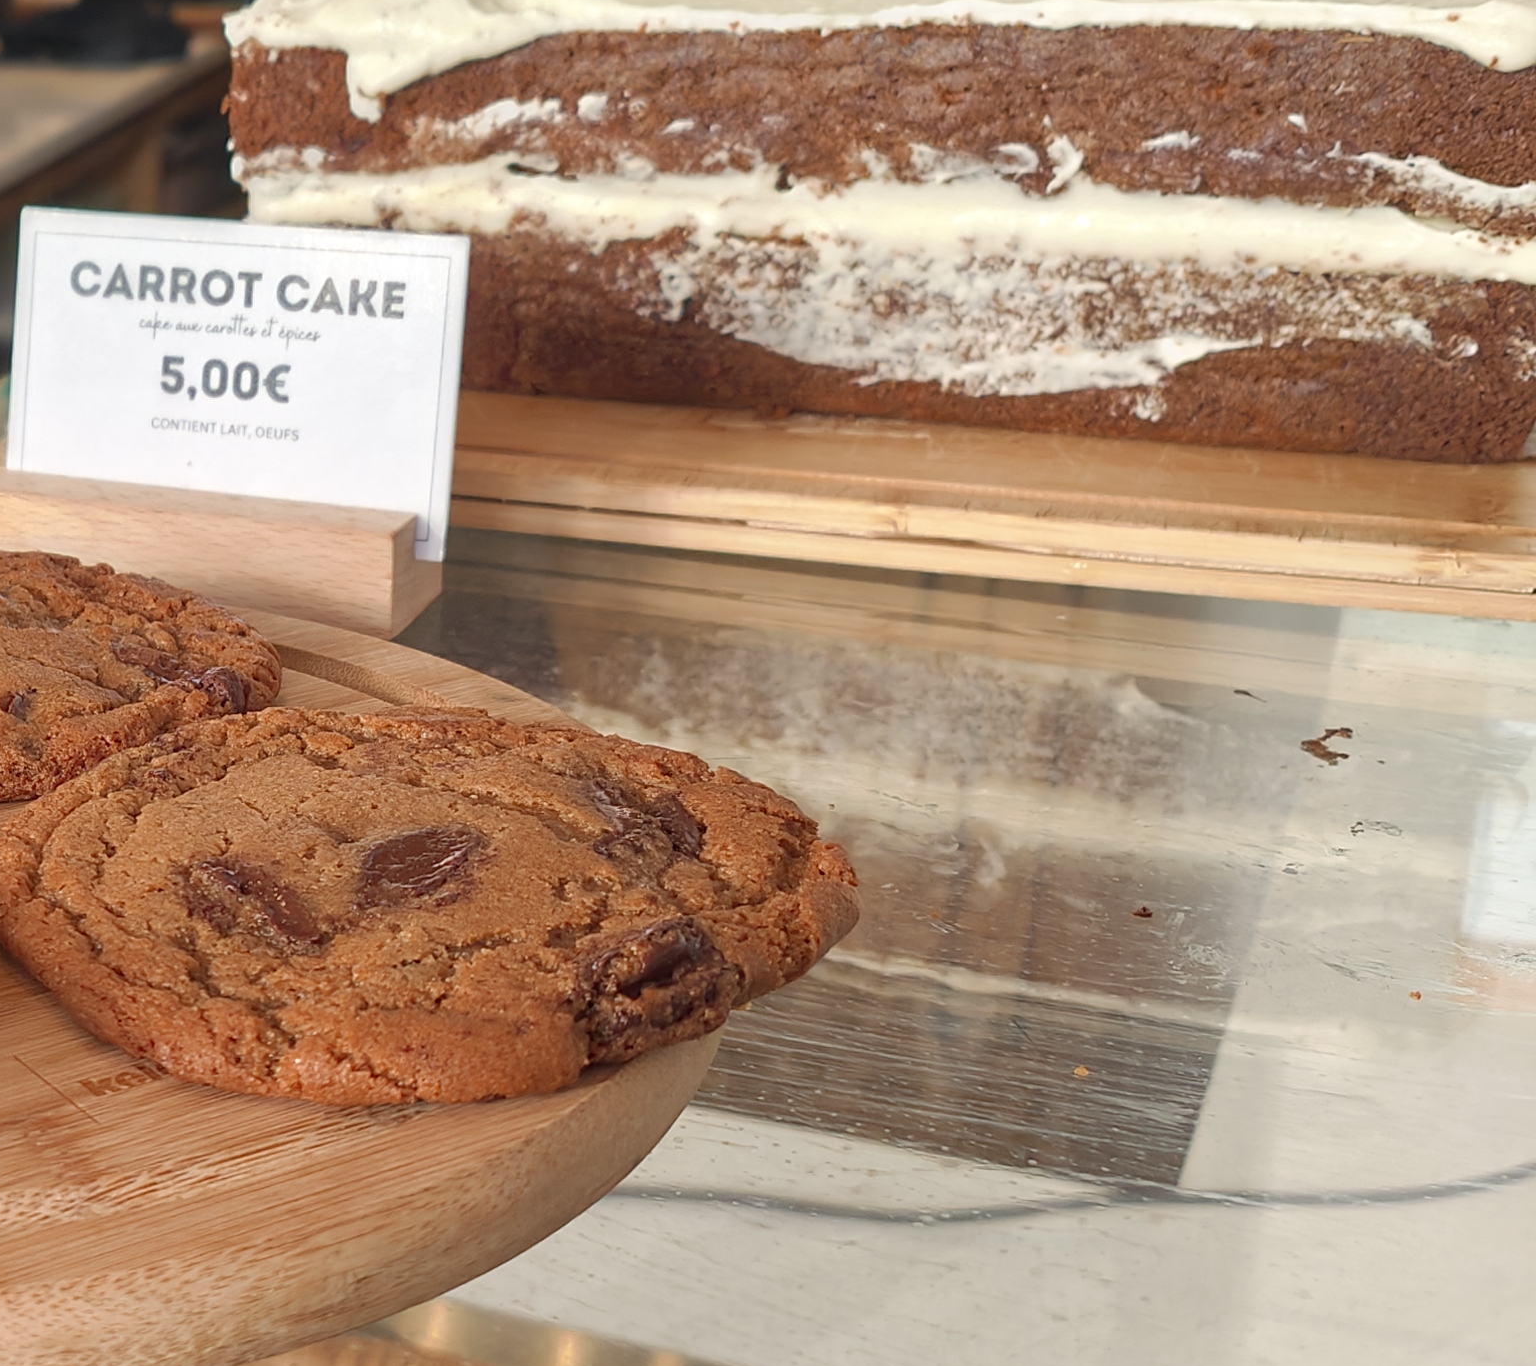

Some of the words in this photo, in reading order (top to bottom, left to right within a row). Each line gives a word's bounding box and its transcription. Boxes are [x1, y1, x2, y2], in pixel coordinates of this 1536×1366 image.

[69, 260, 263, 309] CARROT
[275, 273, 407, 320] CAKE
[175, 321, 202, 333] aux
[205, 313, 257, 337] carottes
[260, 315, 278, 338] et
[278, 325, 321, 351] épices
[160, 355, 292, 404] 5,00€
[150, 416, 218, 434] CONTIENT
[220, 423, 252, 441] LAIT,
[255, 426, 300, 442] OEUFS
